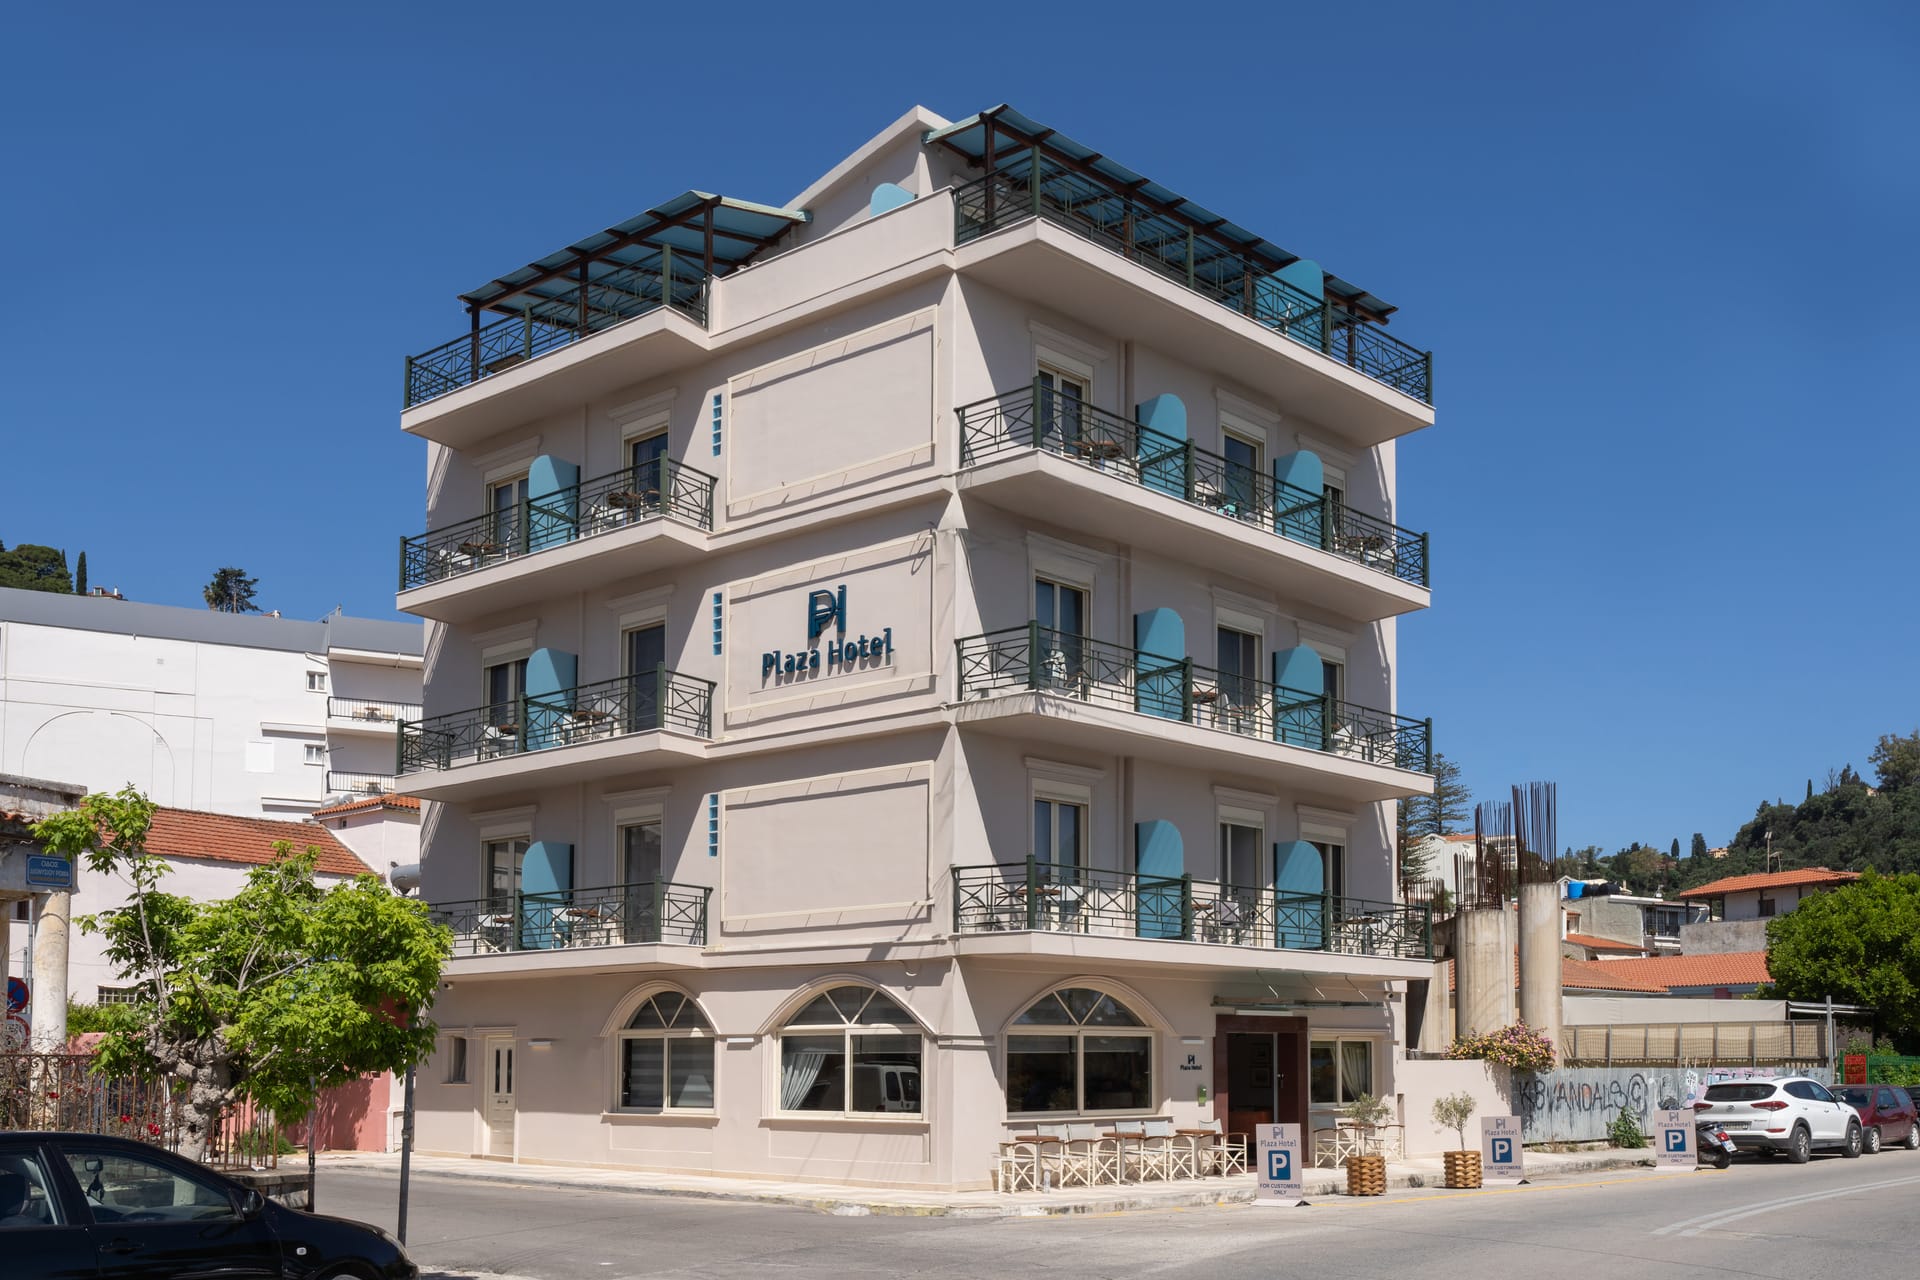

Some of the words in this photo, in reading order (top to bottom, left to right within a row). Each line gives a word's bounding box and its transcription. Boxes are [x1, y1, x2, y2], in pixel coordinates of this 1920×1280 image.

[762, 649, 820, 678] Plaza
[828, 627, 895, 666] Hotel
[1260, 1139, 1277, 1147] Plaza
[1278, 1139, 1296, 1147] Hotel
[1495, 1140, 1509, 1161] P
[1668, 1131, 1683, 1150] P
[1271, 1153, 1288, 1177] P
